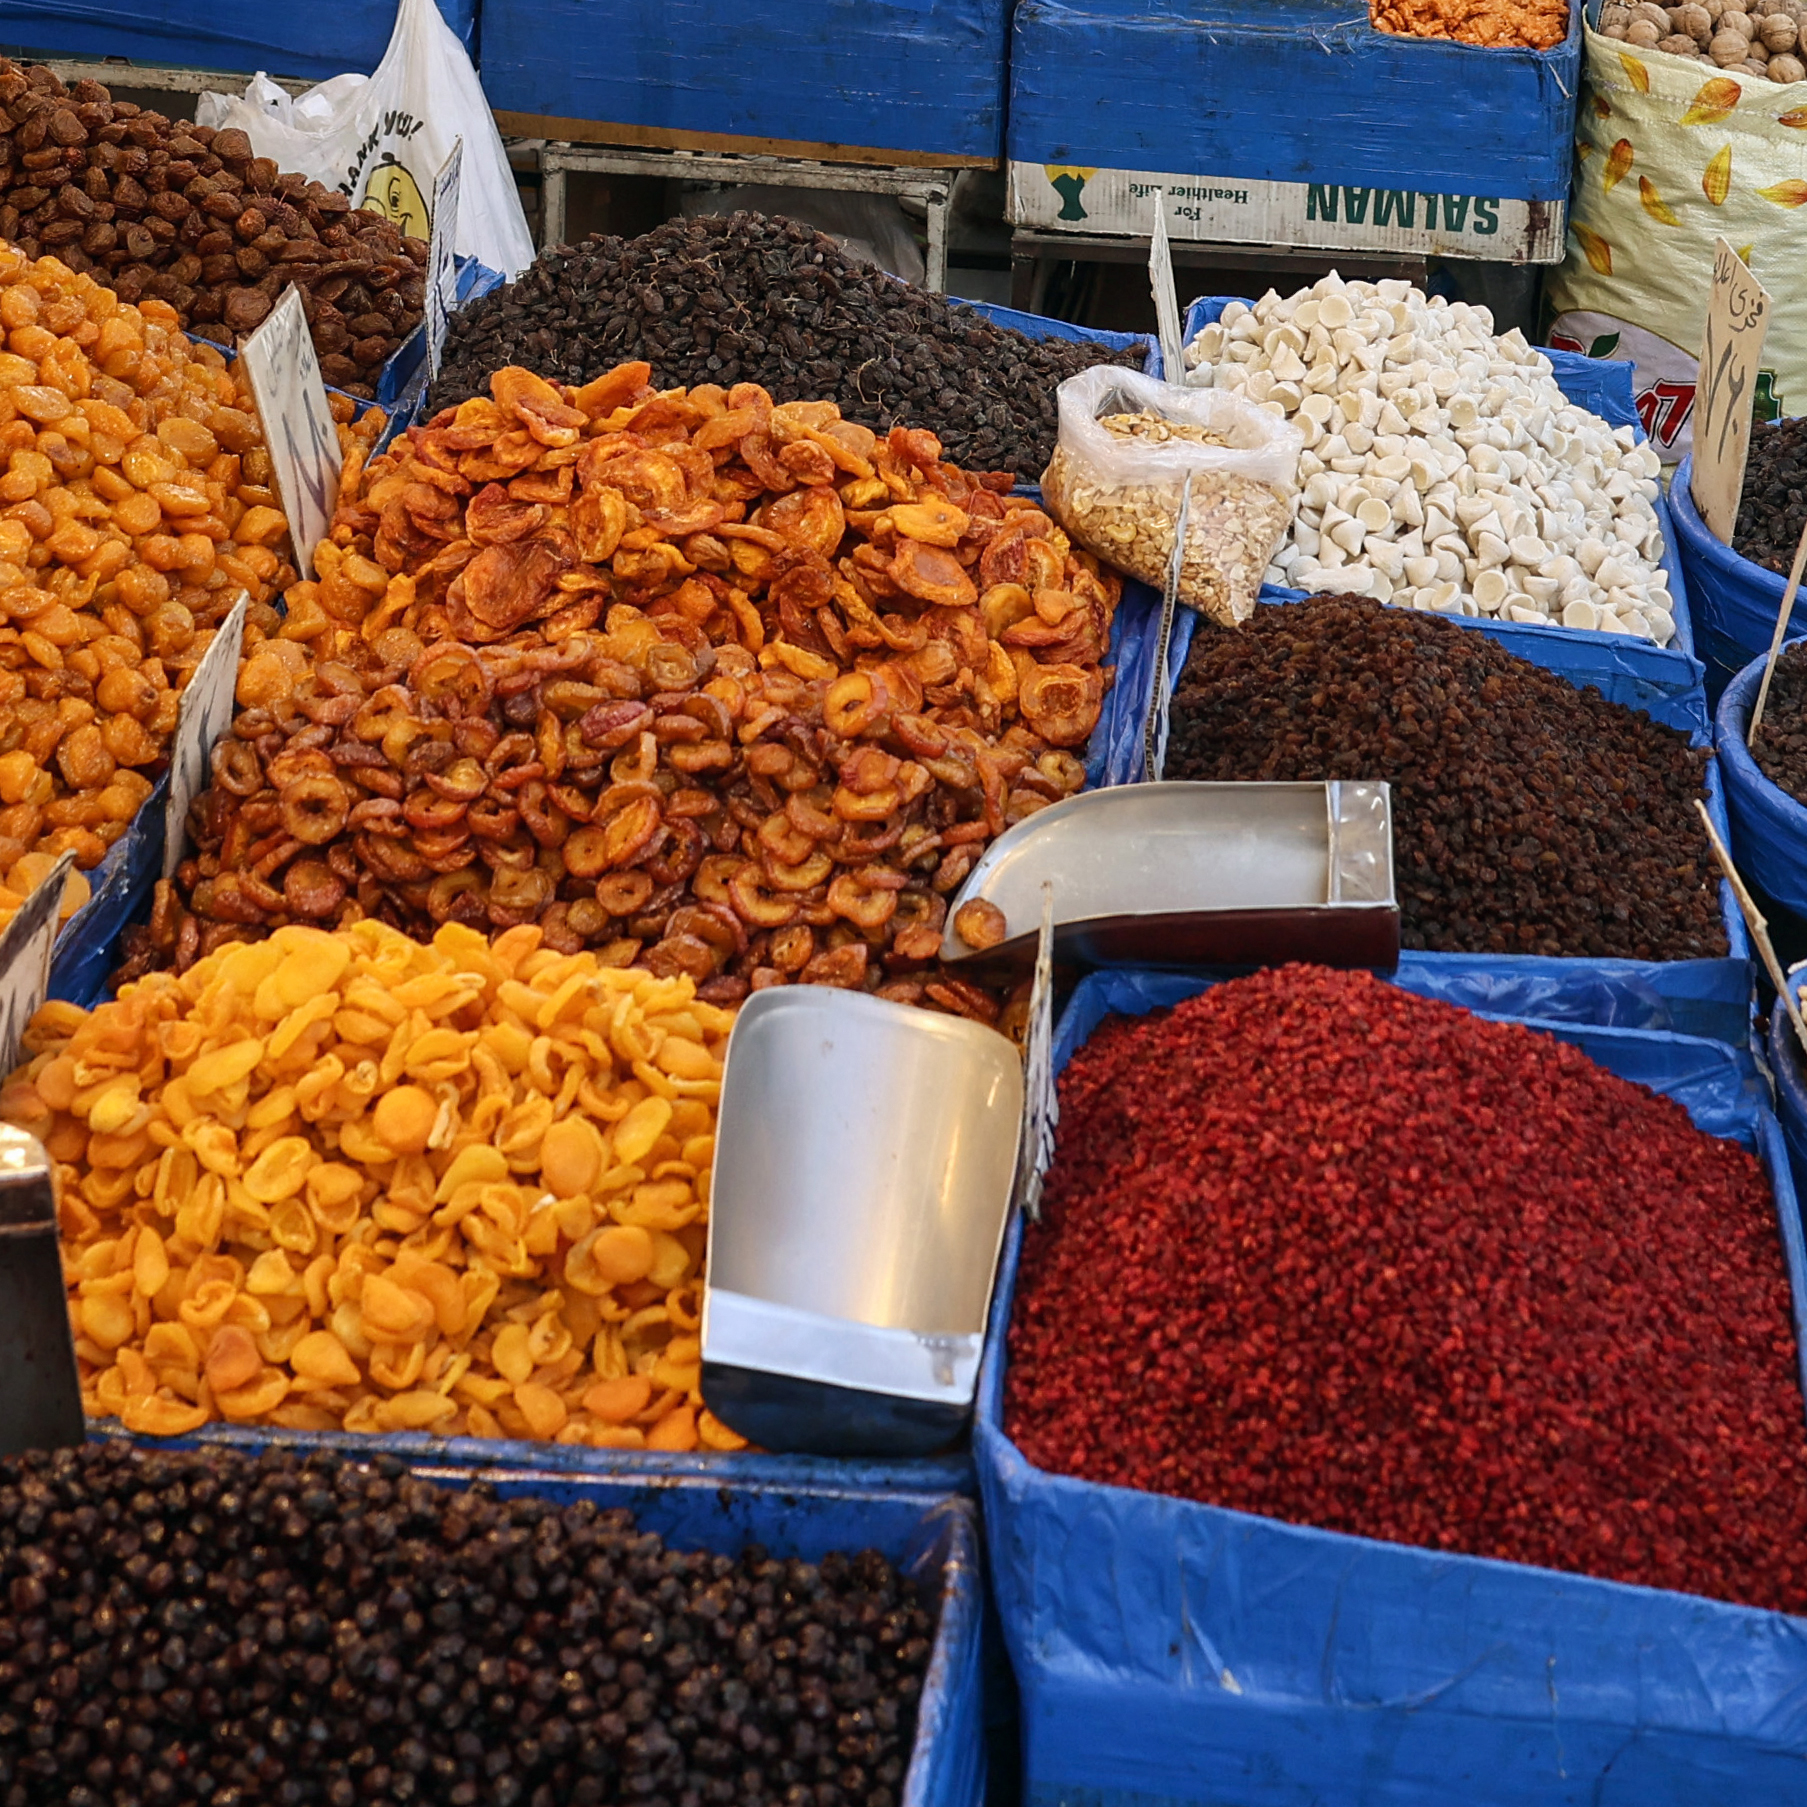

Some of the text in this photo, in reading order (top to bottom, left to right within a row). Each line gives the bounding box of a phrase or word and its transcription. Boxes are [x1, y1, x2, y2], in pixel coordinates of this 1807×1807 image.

[1168, 183, 1249, 205] Healthier
[1174, 204, 1202, 221] For
[1306, 182, 1501, 235] SALMAN
